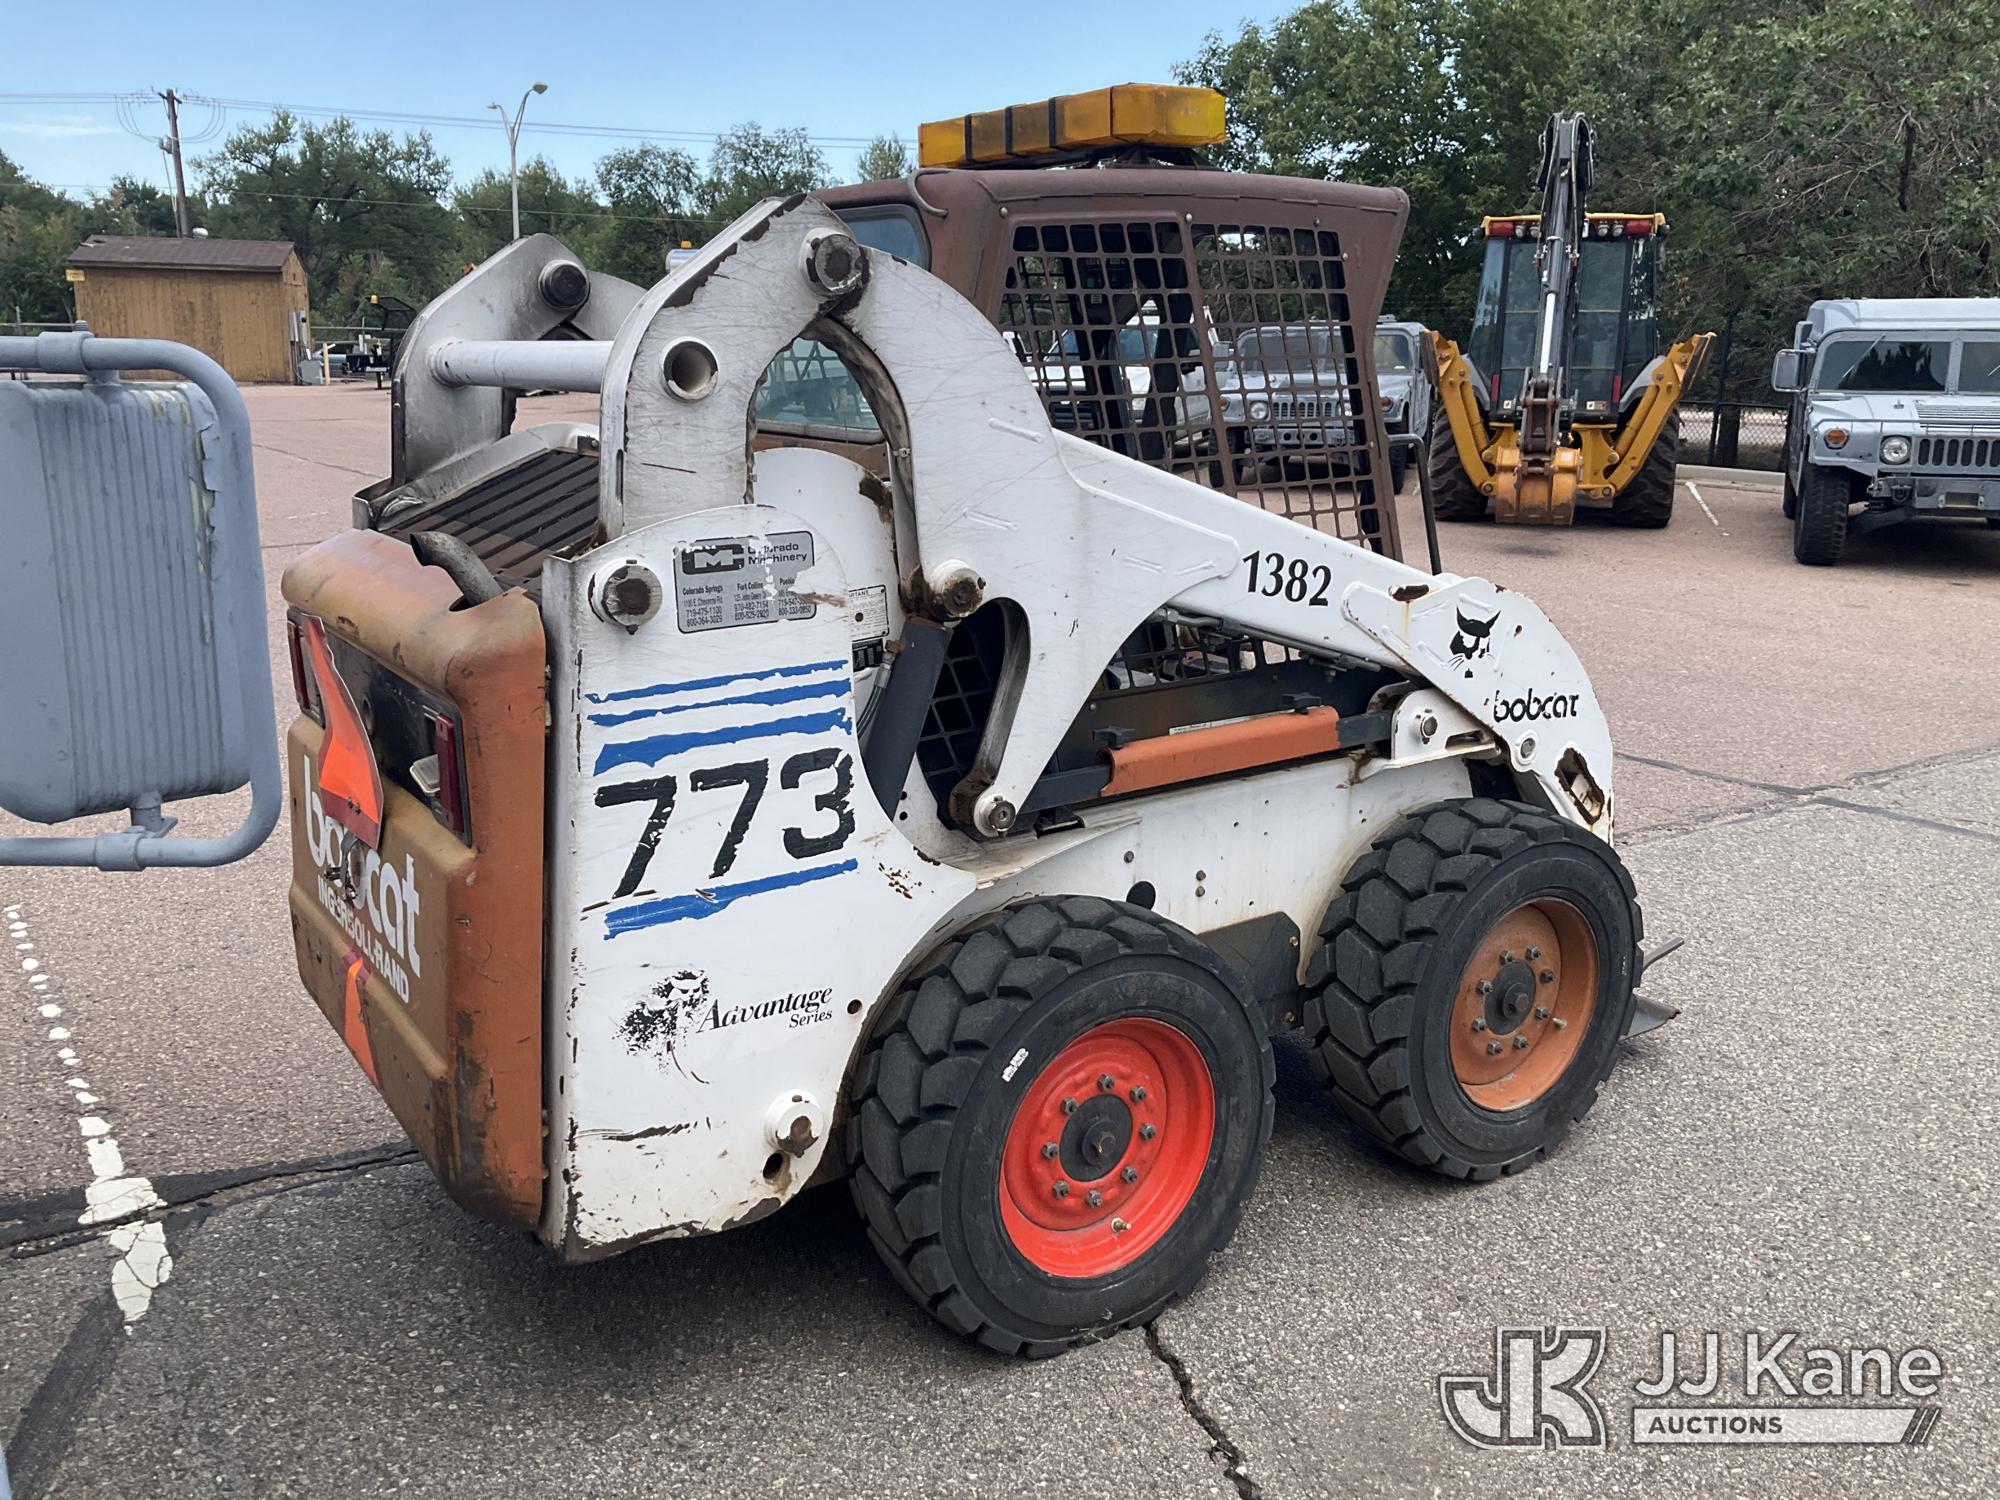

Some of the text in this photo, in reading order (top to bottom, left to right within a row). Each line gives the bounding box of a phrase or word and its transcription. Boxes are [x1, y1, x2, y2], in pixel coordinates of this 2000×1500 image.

[747, 542, 799, 555] Clorado
[1242, 550, 1332, 607] 1382
[1493, 687, 1580, 723] bobcat
[594, 747, 856, 899] 773
[694, 986, 833, 1034] Advantage
[788, 1008, 833, 1029] Series
